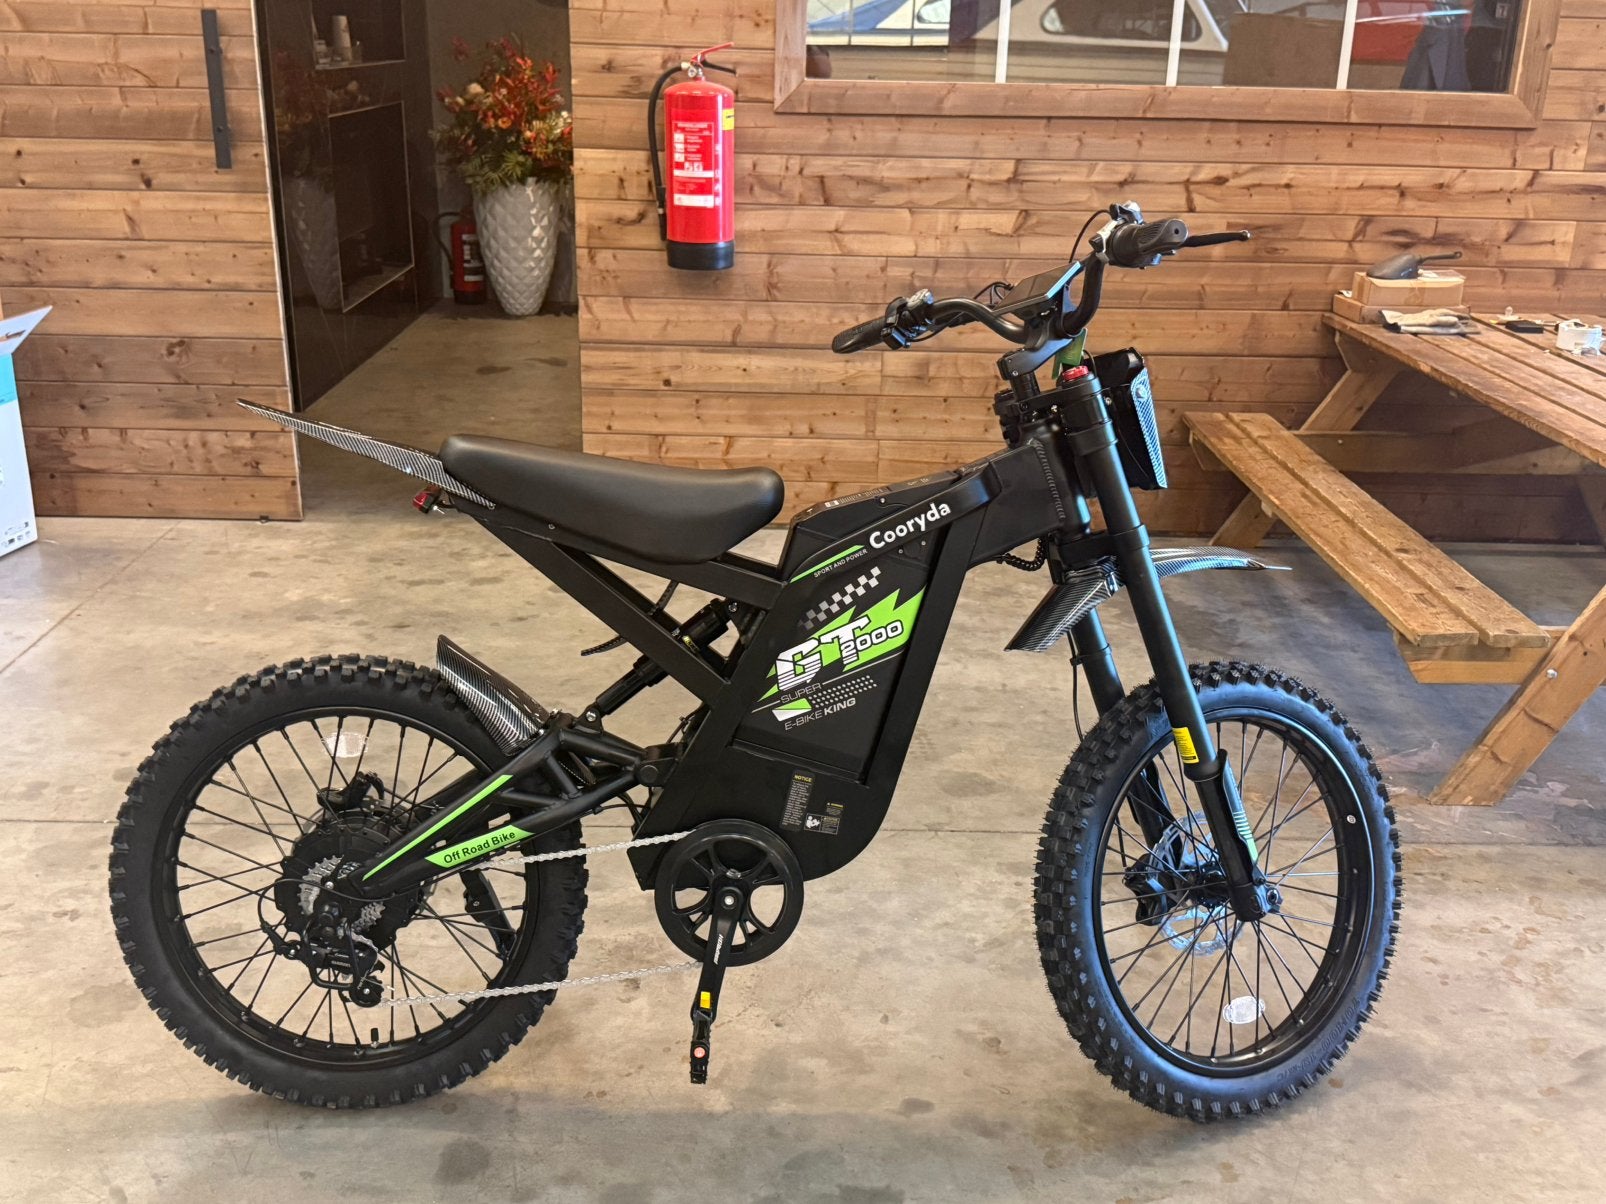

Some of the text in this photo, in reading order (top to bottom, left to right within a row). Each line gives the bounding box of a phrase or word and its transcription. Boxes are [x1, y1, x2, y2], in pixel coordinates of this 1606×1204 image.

[869, 502, 951, 549] Cooryda
[813, 548, 868, 578] SPORT AND POWER
[841, 620, 903, 657] 2000
[780, 682, 822, 703] SUPER
[784, 697, 856, 731] E-BIKE KING
[443, 832, 515, 863] Off Road Bike
